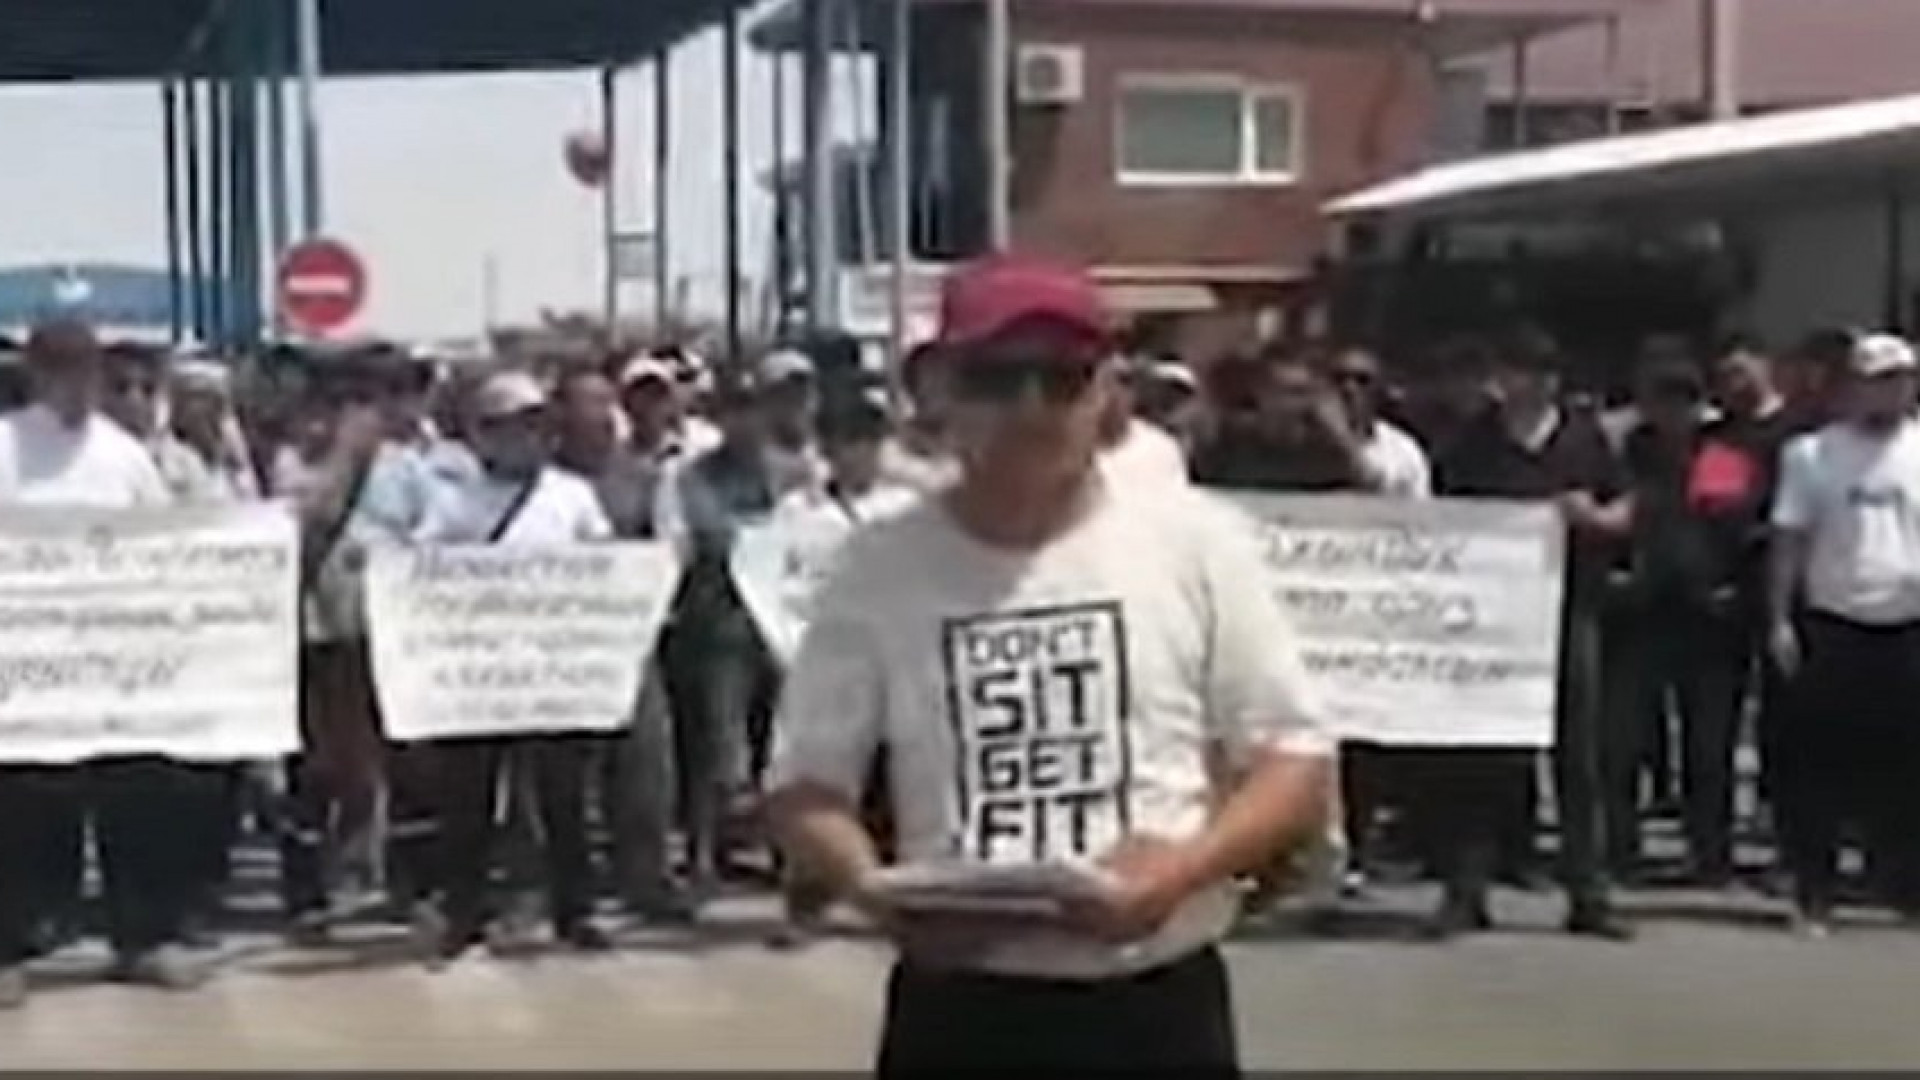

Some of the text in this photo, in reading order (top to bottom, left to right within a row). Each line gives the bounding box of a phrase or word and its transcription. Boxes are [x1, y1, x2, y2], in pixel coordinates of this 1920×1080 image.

[973, 661, 1102, 739] SIT
[979, 733, 1106, 792] GET
[979, 789, 1107, 862] FIT
